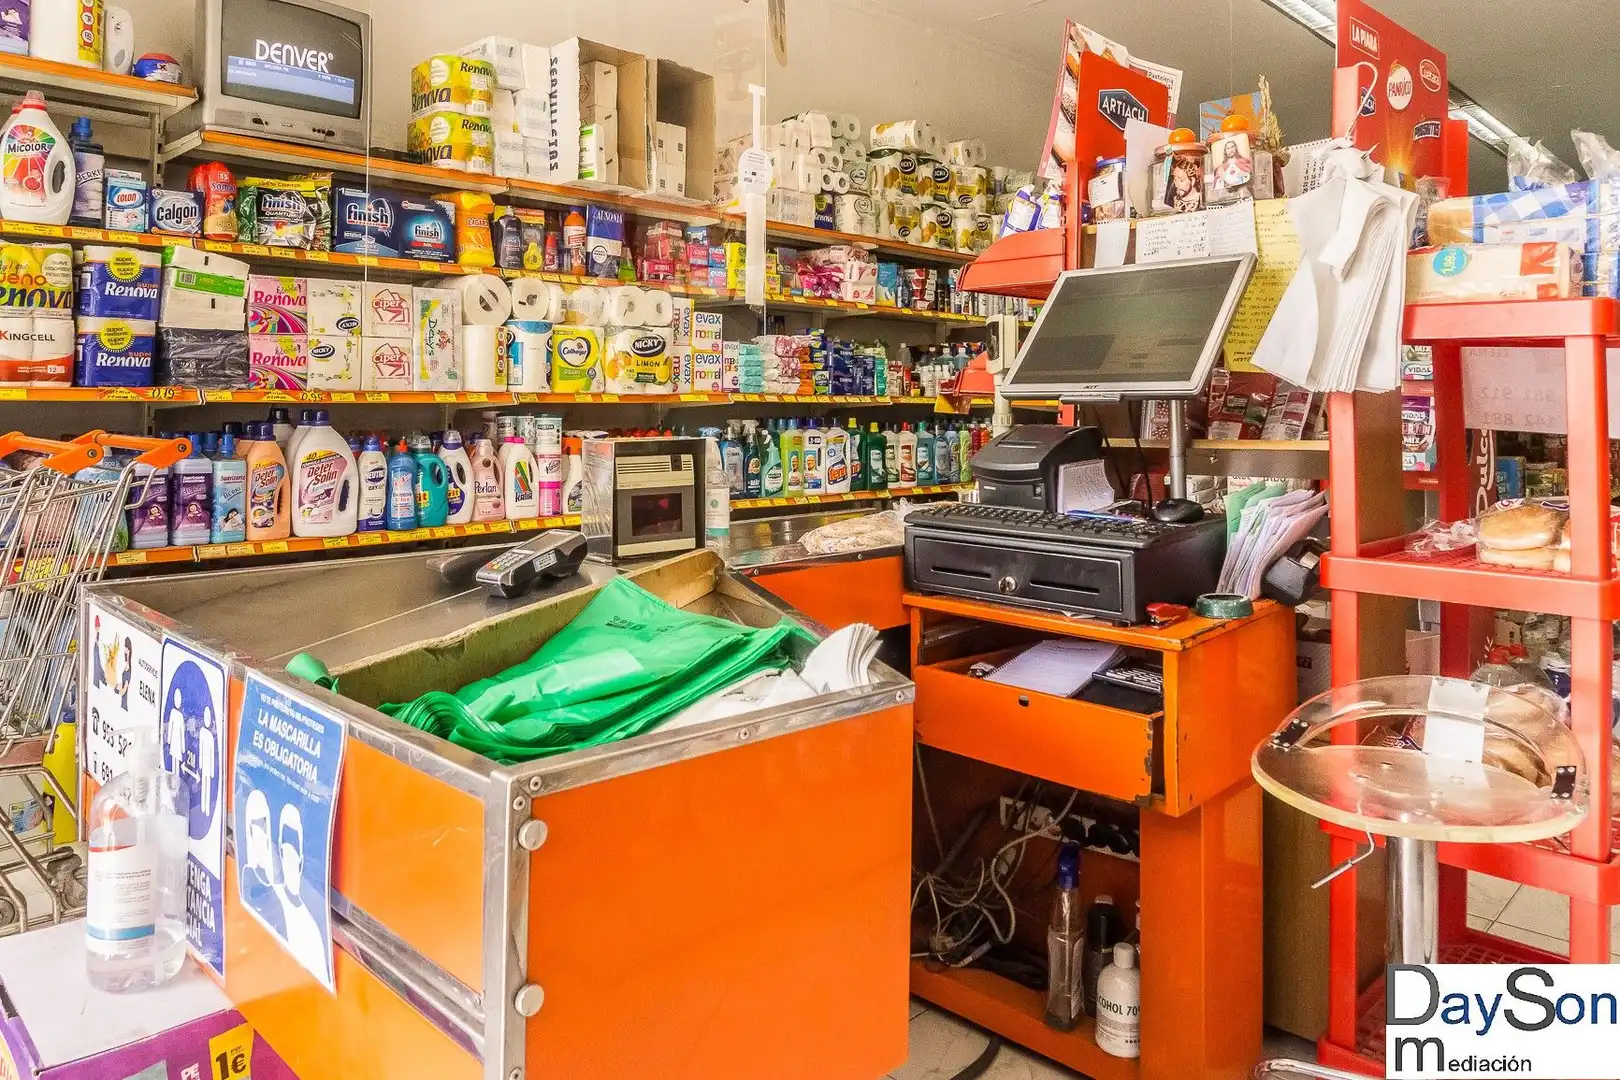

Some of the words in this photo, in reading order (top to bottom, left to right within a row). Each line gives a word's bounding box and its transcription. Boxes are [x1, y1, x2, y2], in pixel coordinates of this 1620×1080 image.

[255, 38, 329, 74] DENVER
[460, 61, 493, 77] Renov
[1102, 96, 1145, 122] ARTIACH
[461, 119, 492, 133] Renov
[261, 194, 303, 213] finish
[156, 204, 197, 225] Calgon
[347, 203, 389, 224] finish
[414, 224, 440, 238] finish
[104, 282, 158, 299] Renova
[253, 291, 307, 306] Renova
[695, 313, 721, 324] evax
[0, 330, 56, 342] KINGCELL
[634, 339, 659, 349] NICKY
[96, 352, 151, 368] Renova
[252, 352, 307, 366] Renova
[695, 353, 721, 365] evax
[255, 469, 275, 482] Deter
[307, 463, 333, 479] Deter
[313, 470, 338, 486] Solin
[259, 476, 278, 488] Solin
[474, 481, 497, 495] Perlan
[139, 680, 157, 708] ELENA
[257, 708, 268, 728] LA
[269, 714, 322, 759] MASCARILLA
[252, 730, 264, 750] ES
[264, 737, 319, 783] OBLIGATORIA
